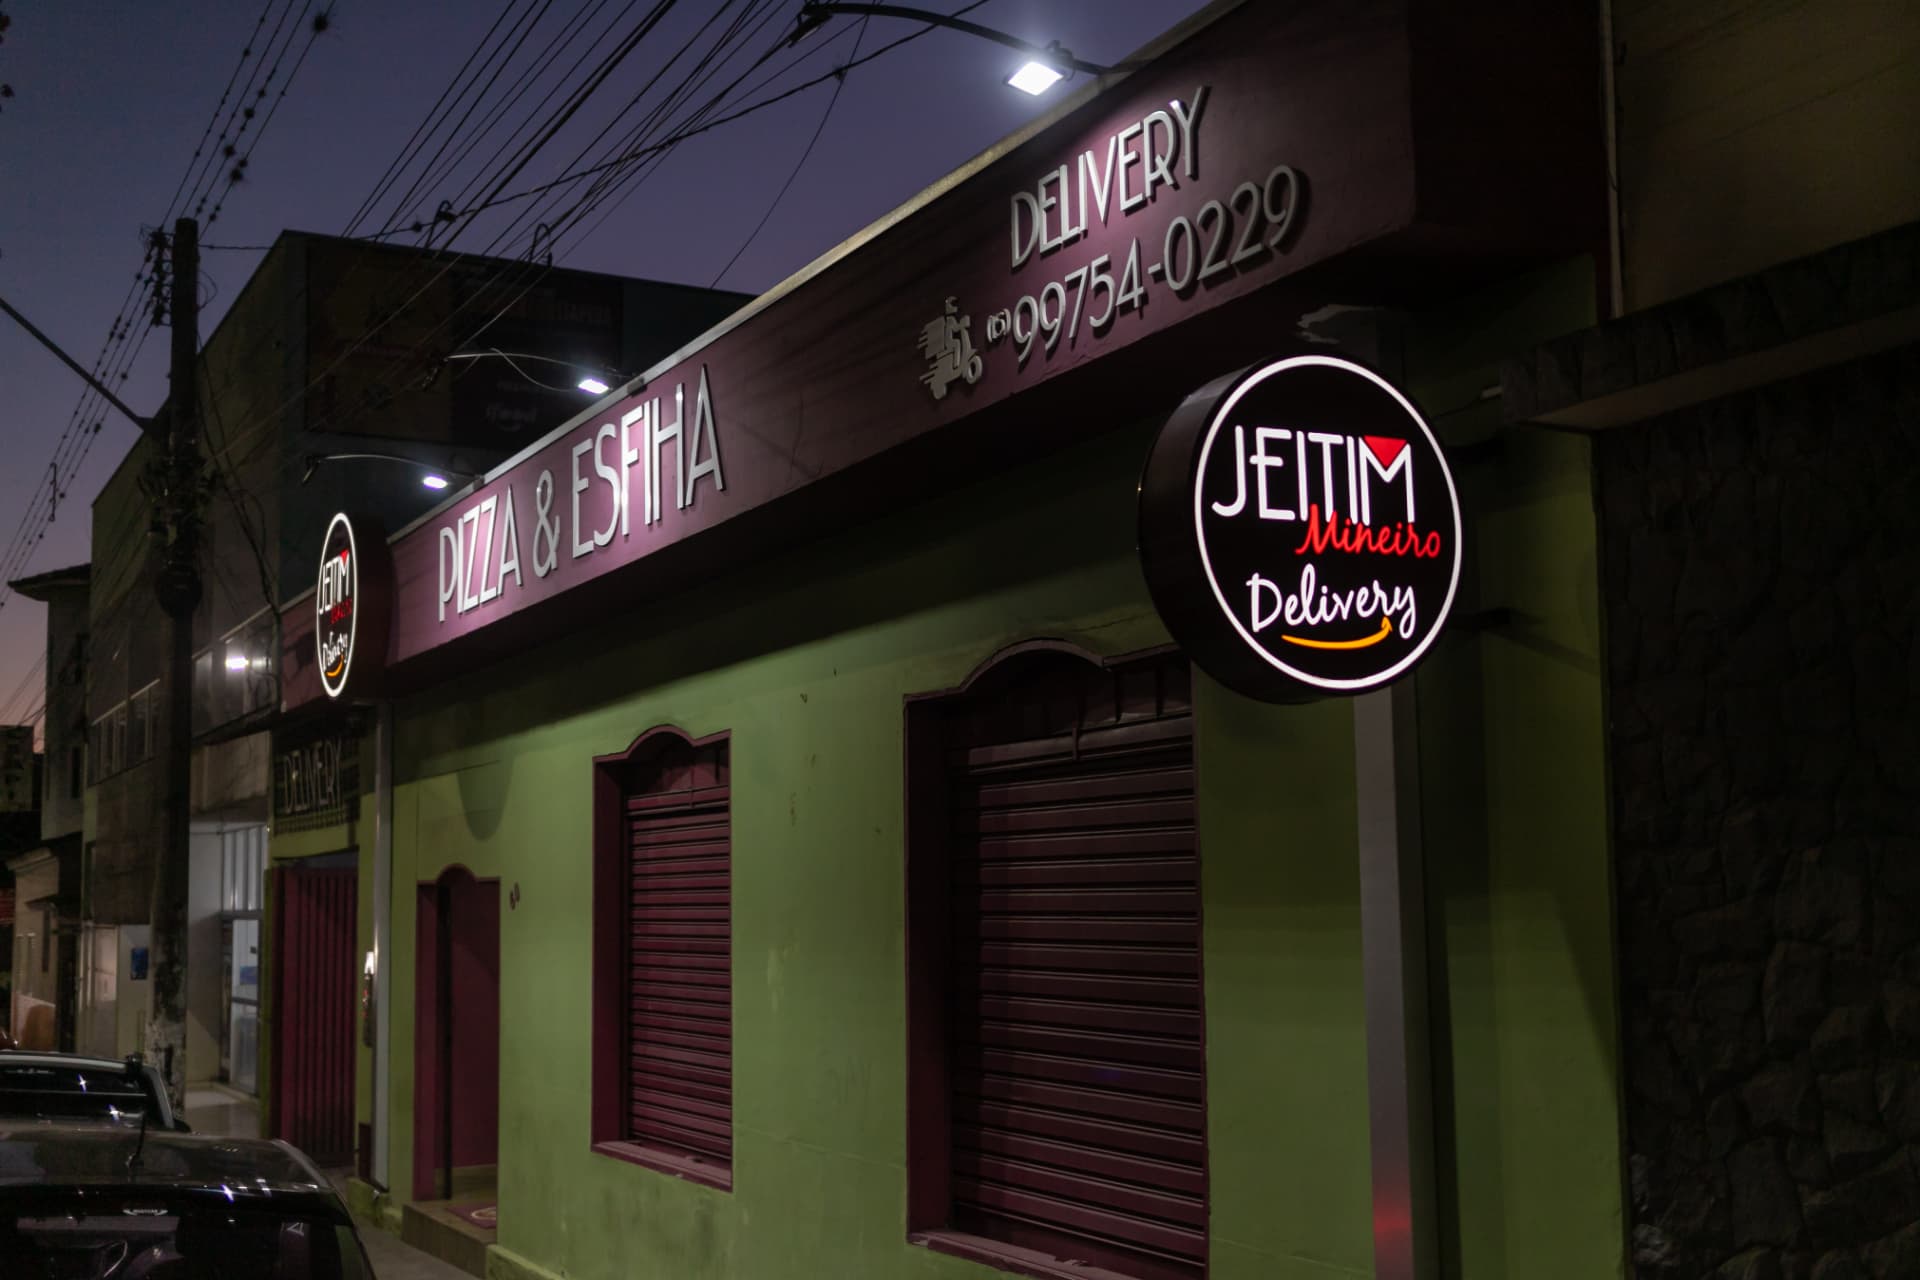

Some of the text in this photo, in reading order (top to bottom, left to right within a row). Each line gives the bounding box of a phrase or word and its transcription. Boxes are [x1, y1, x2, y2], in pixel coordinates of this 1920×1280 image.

[1010, 85, 1209, 269] DELIVERY
[438, 363, 725, 622] PIZZA & ESFIHA
[1211, 424, 1416, 527] JEITIM
[1293, 502, 1442, 559] Mineiro
[1245, 562, 1417, 640] Delivery
[283, 736, 342, 814] DELIVERY
